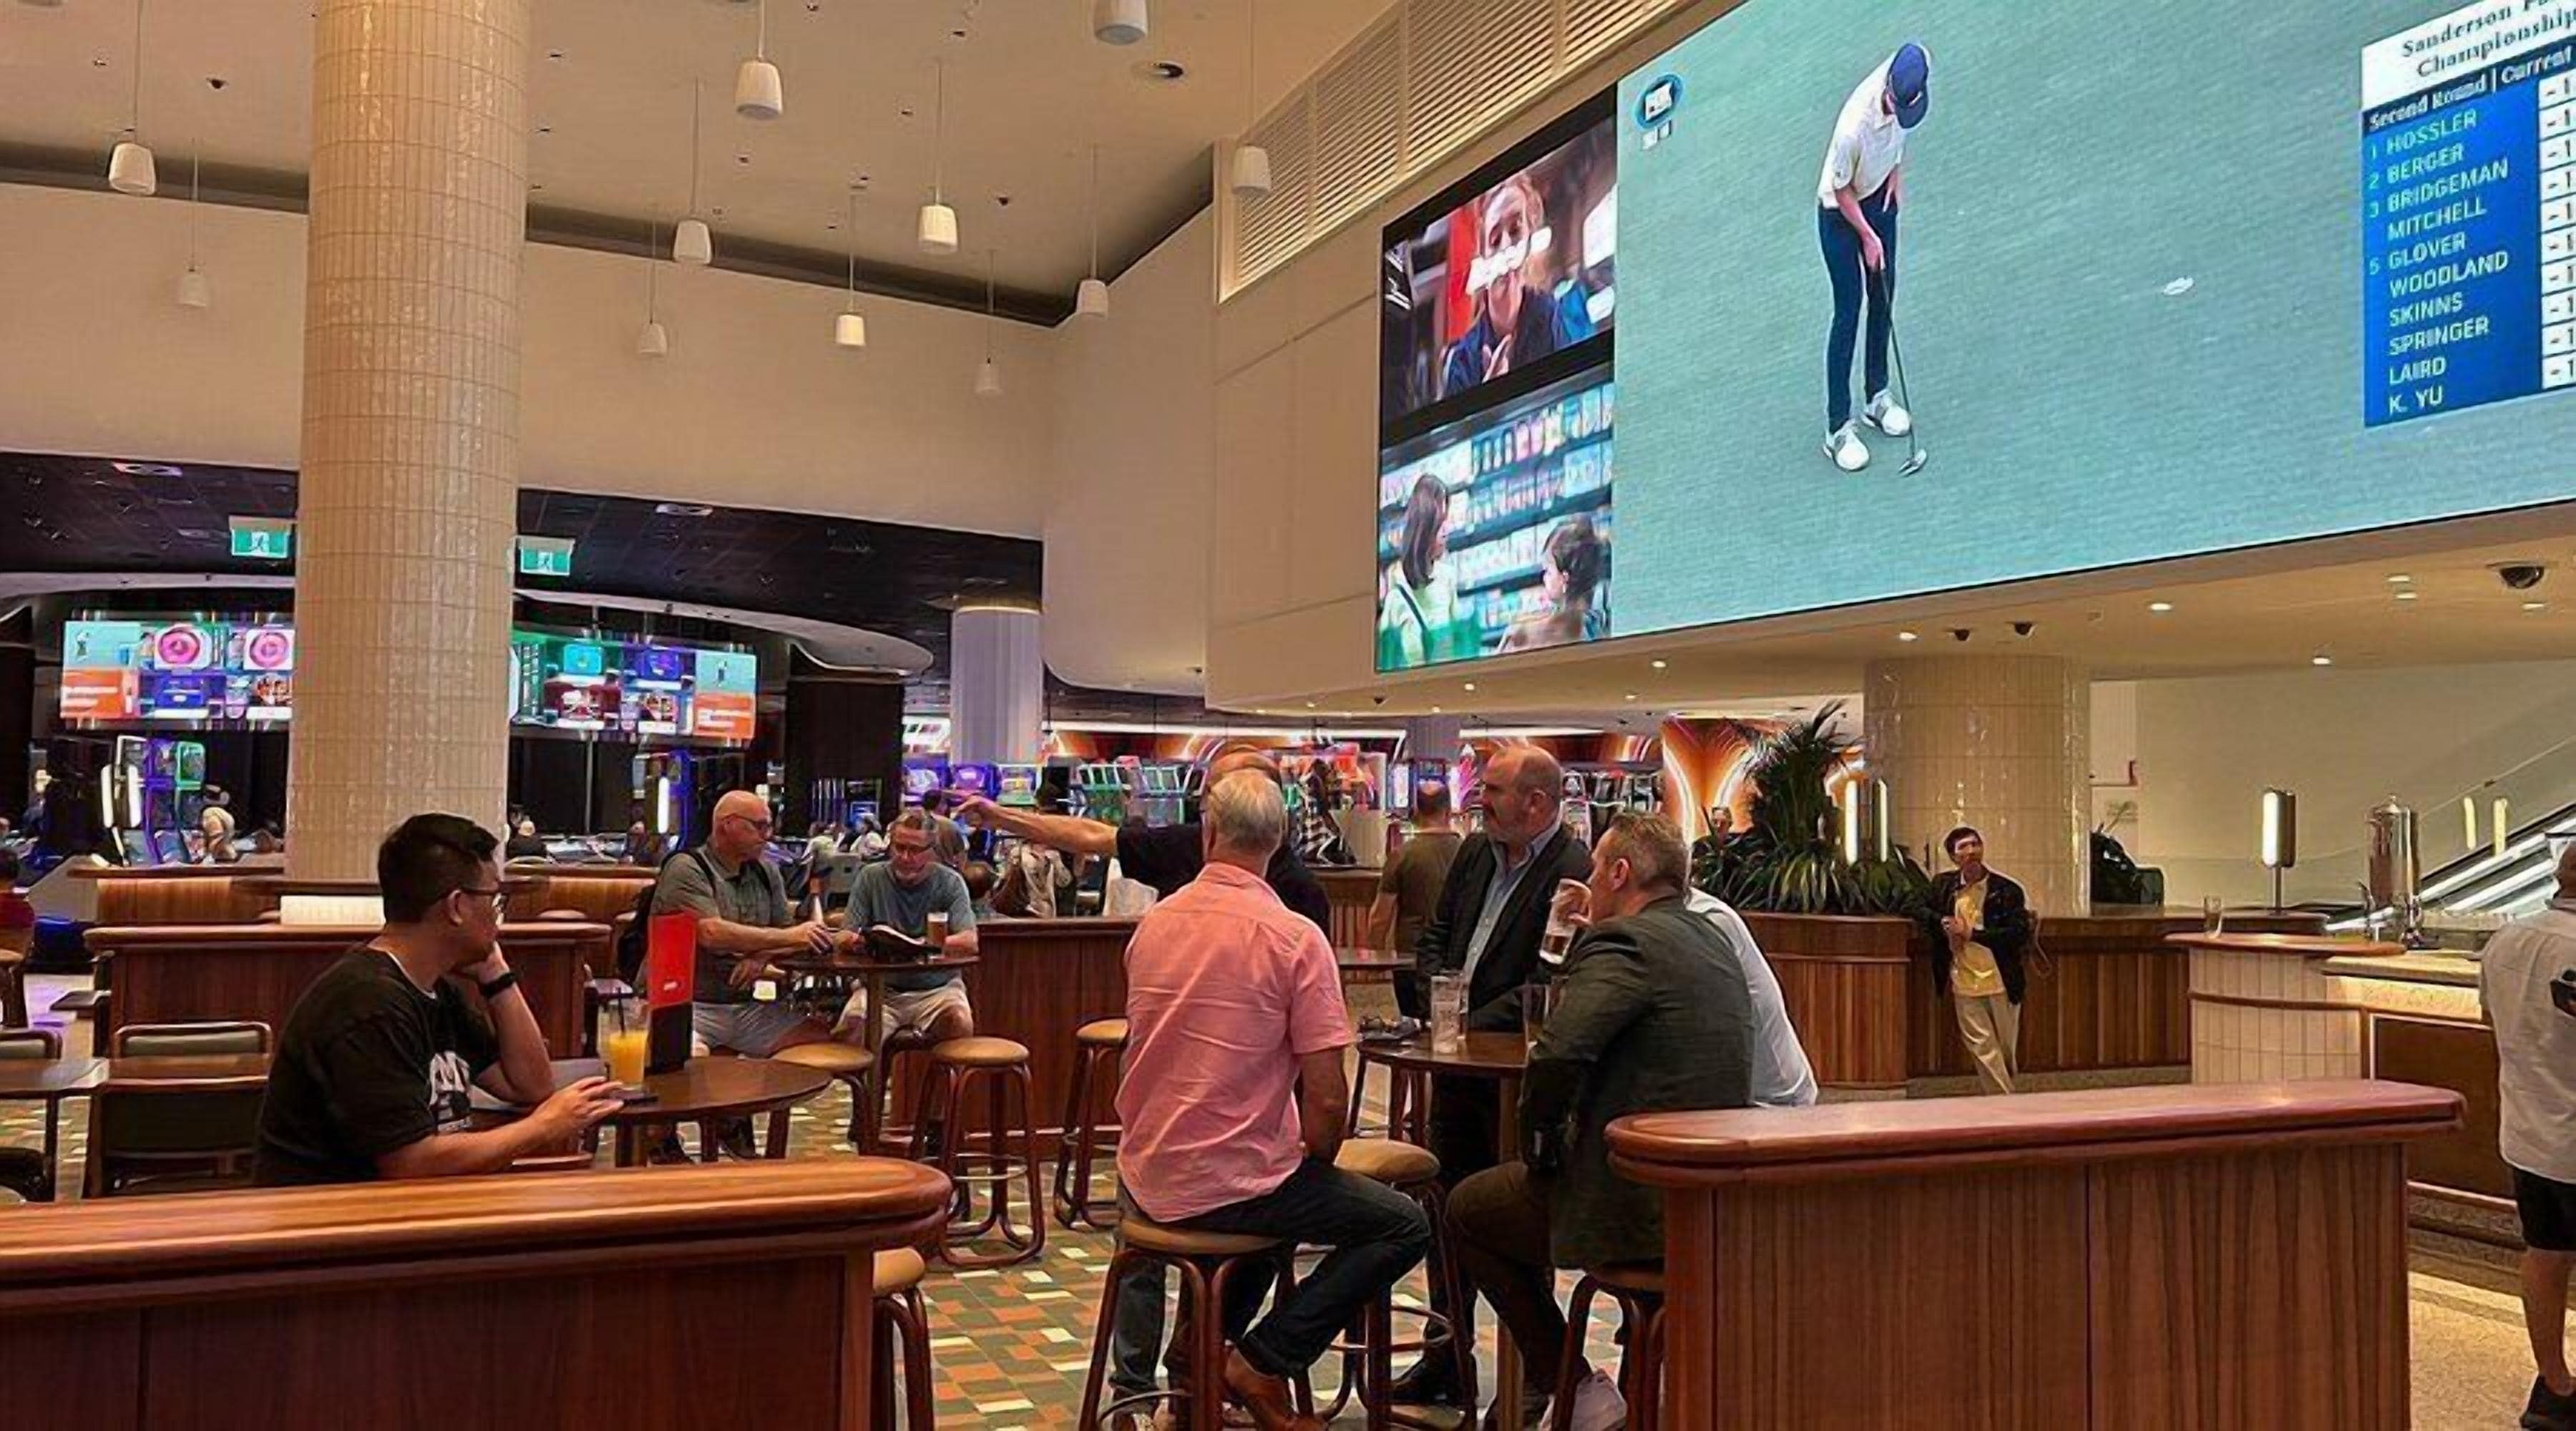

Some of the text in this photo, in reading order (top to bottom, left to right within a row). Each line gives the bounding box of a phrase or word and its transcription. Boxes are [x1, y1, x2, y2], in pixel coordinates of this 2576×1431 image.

[2402, 5, 2511, 57] Sanderson
[2369, 46, 2572, 132] Second Round Current
[2387, 109, 2477, 155] HOSSLER
[2369, 174, 2379, 189] 2
[2388, 143, 2464, 184] BERGER
[2388, 157, 2508, 213] BRIDGEMAN
[2388, 196, 2487, 240] MITCHELL
[2369, 258, 2380, 275] 5
[2389, 232, 2466, 269] GLOVER
[2389, 251, 2508, 298] WOODLAND
[2389, 292, 2463, 326] SKINNS
[2389, 315, 2489, 355] SPRINGER
[2389, 356, 2446, 384] LAIRD
[2416, 386, 2444, 409] YU
